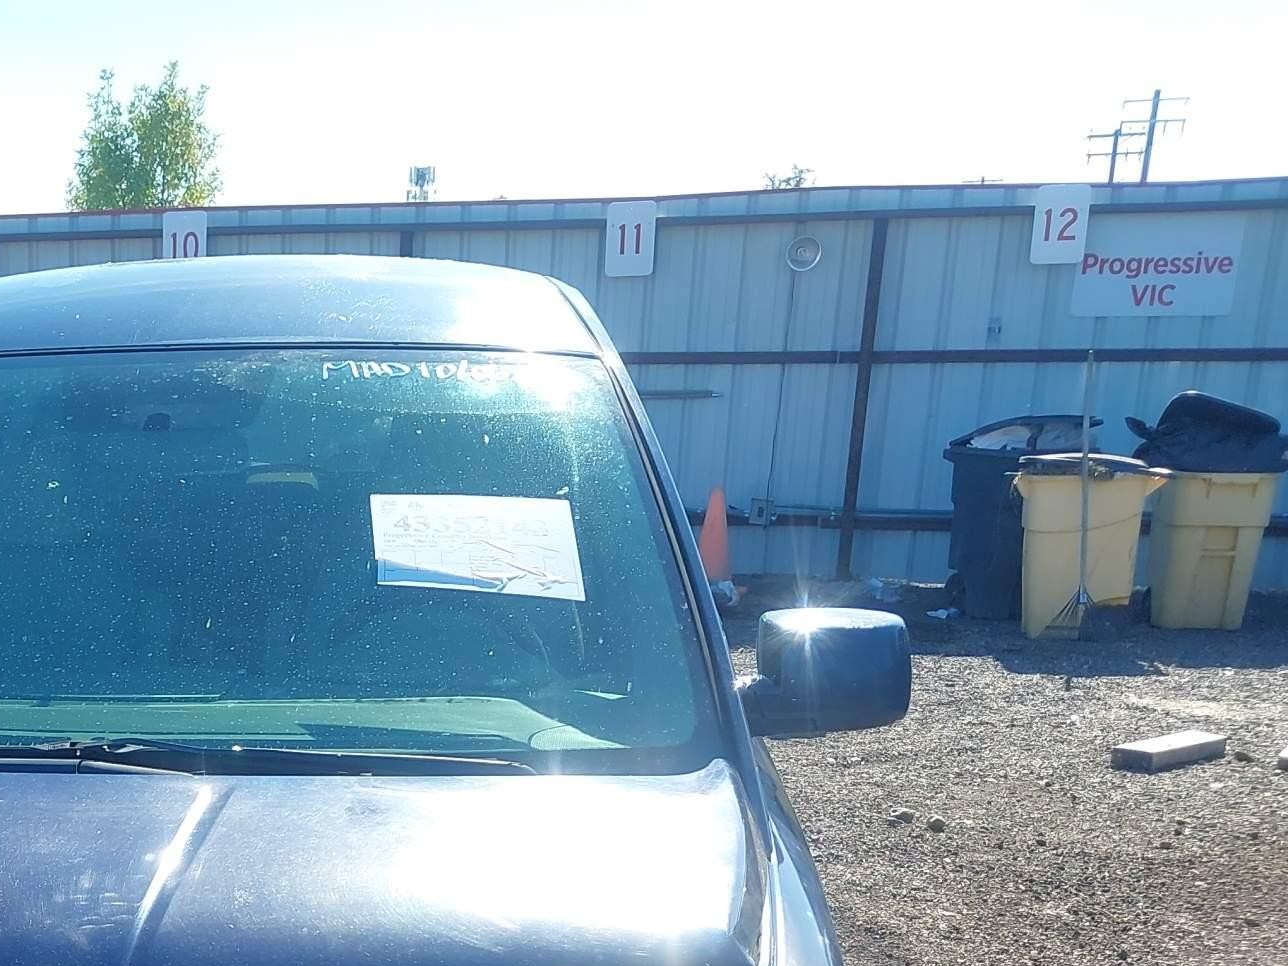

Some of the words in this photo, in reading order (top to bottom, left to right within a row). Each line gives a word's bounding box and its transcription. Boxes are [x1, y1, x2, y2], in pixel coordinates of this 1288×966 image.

[1043, 207, 1079, 242] 12
[171, 231, 199, 259] 10
[619, 223, 641, 255] 11
[1081, 251, 1233, 279] Progressive
[1131, 284, 1176, 306] VIC
